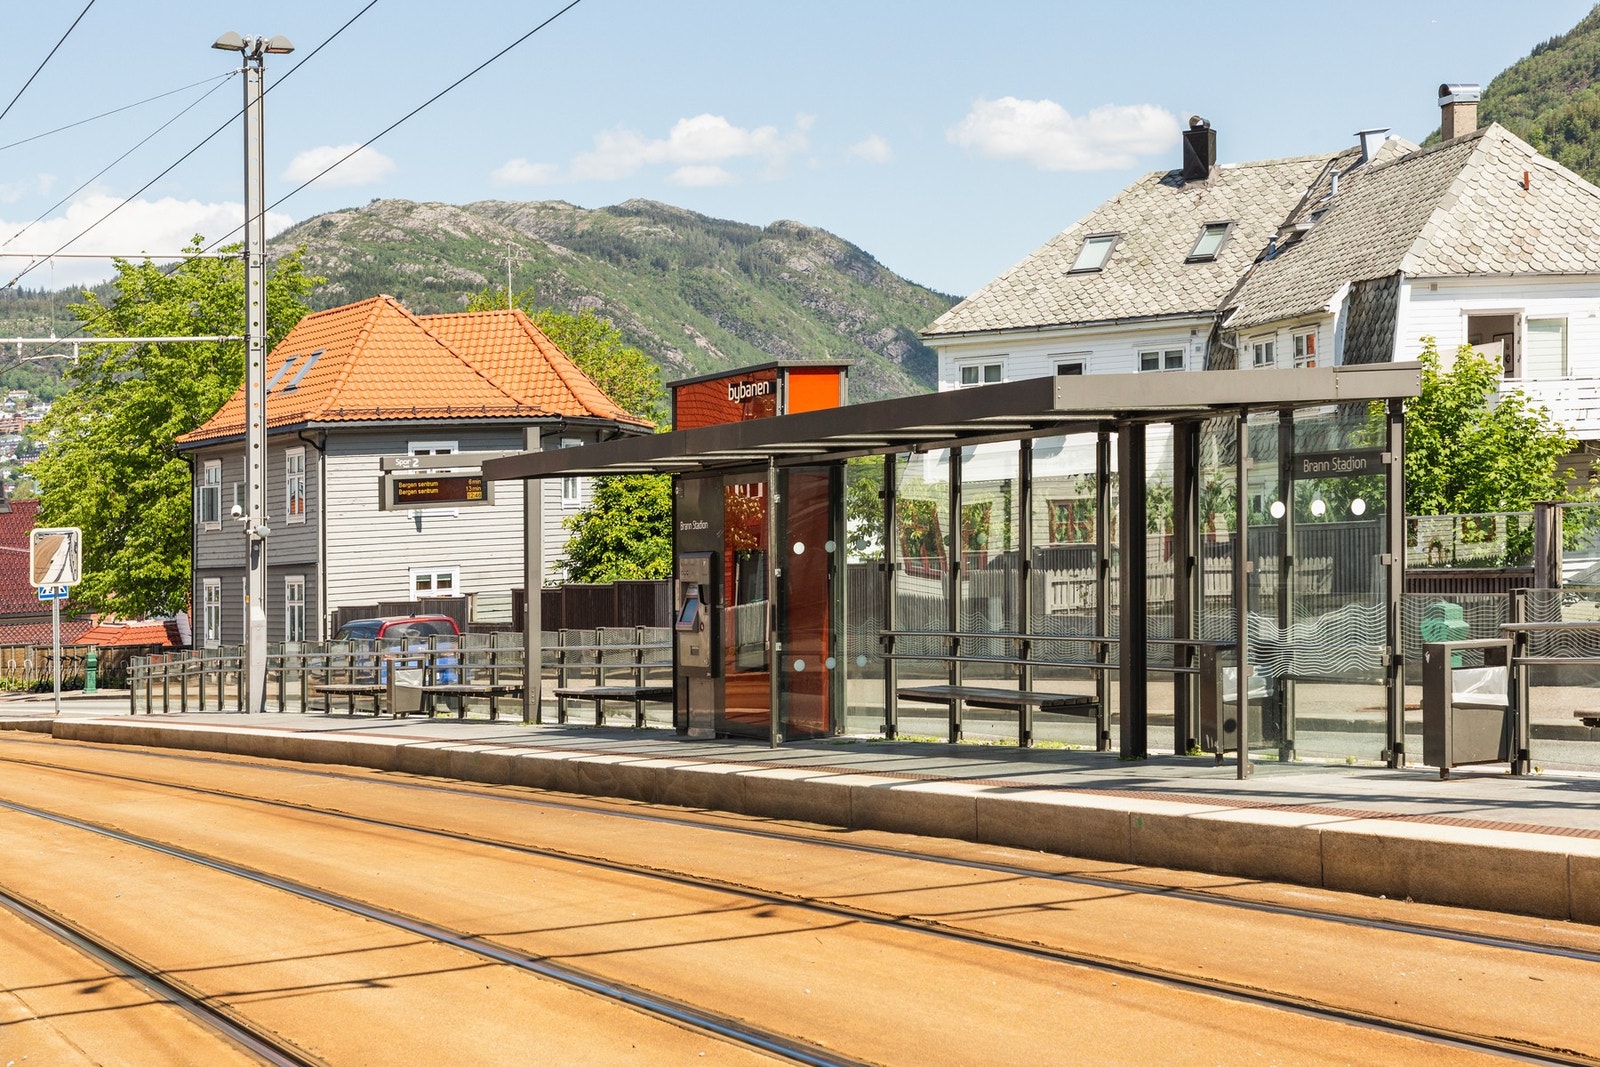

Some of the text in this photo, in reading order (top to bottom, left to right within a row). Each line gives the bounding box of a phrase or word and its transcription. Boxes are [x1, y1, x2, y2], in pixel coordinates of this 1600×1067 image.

[728, 381, 770, 404] bybanen
[395, 458, 411, 466] Spor
[412, 458, 419, 467] 2
[1303, 455, 1367, 473] Brann Stadion
[680, 520, 709, 530] Brann Stadion
